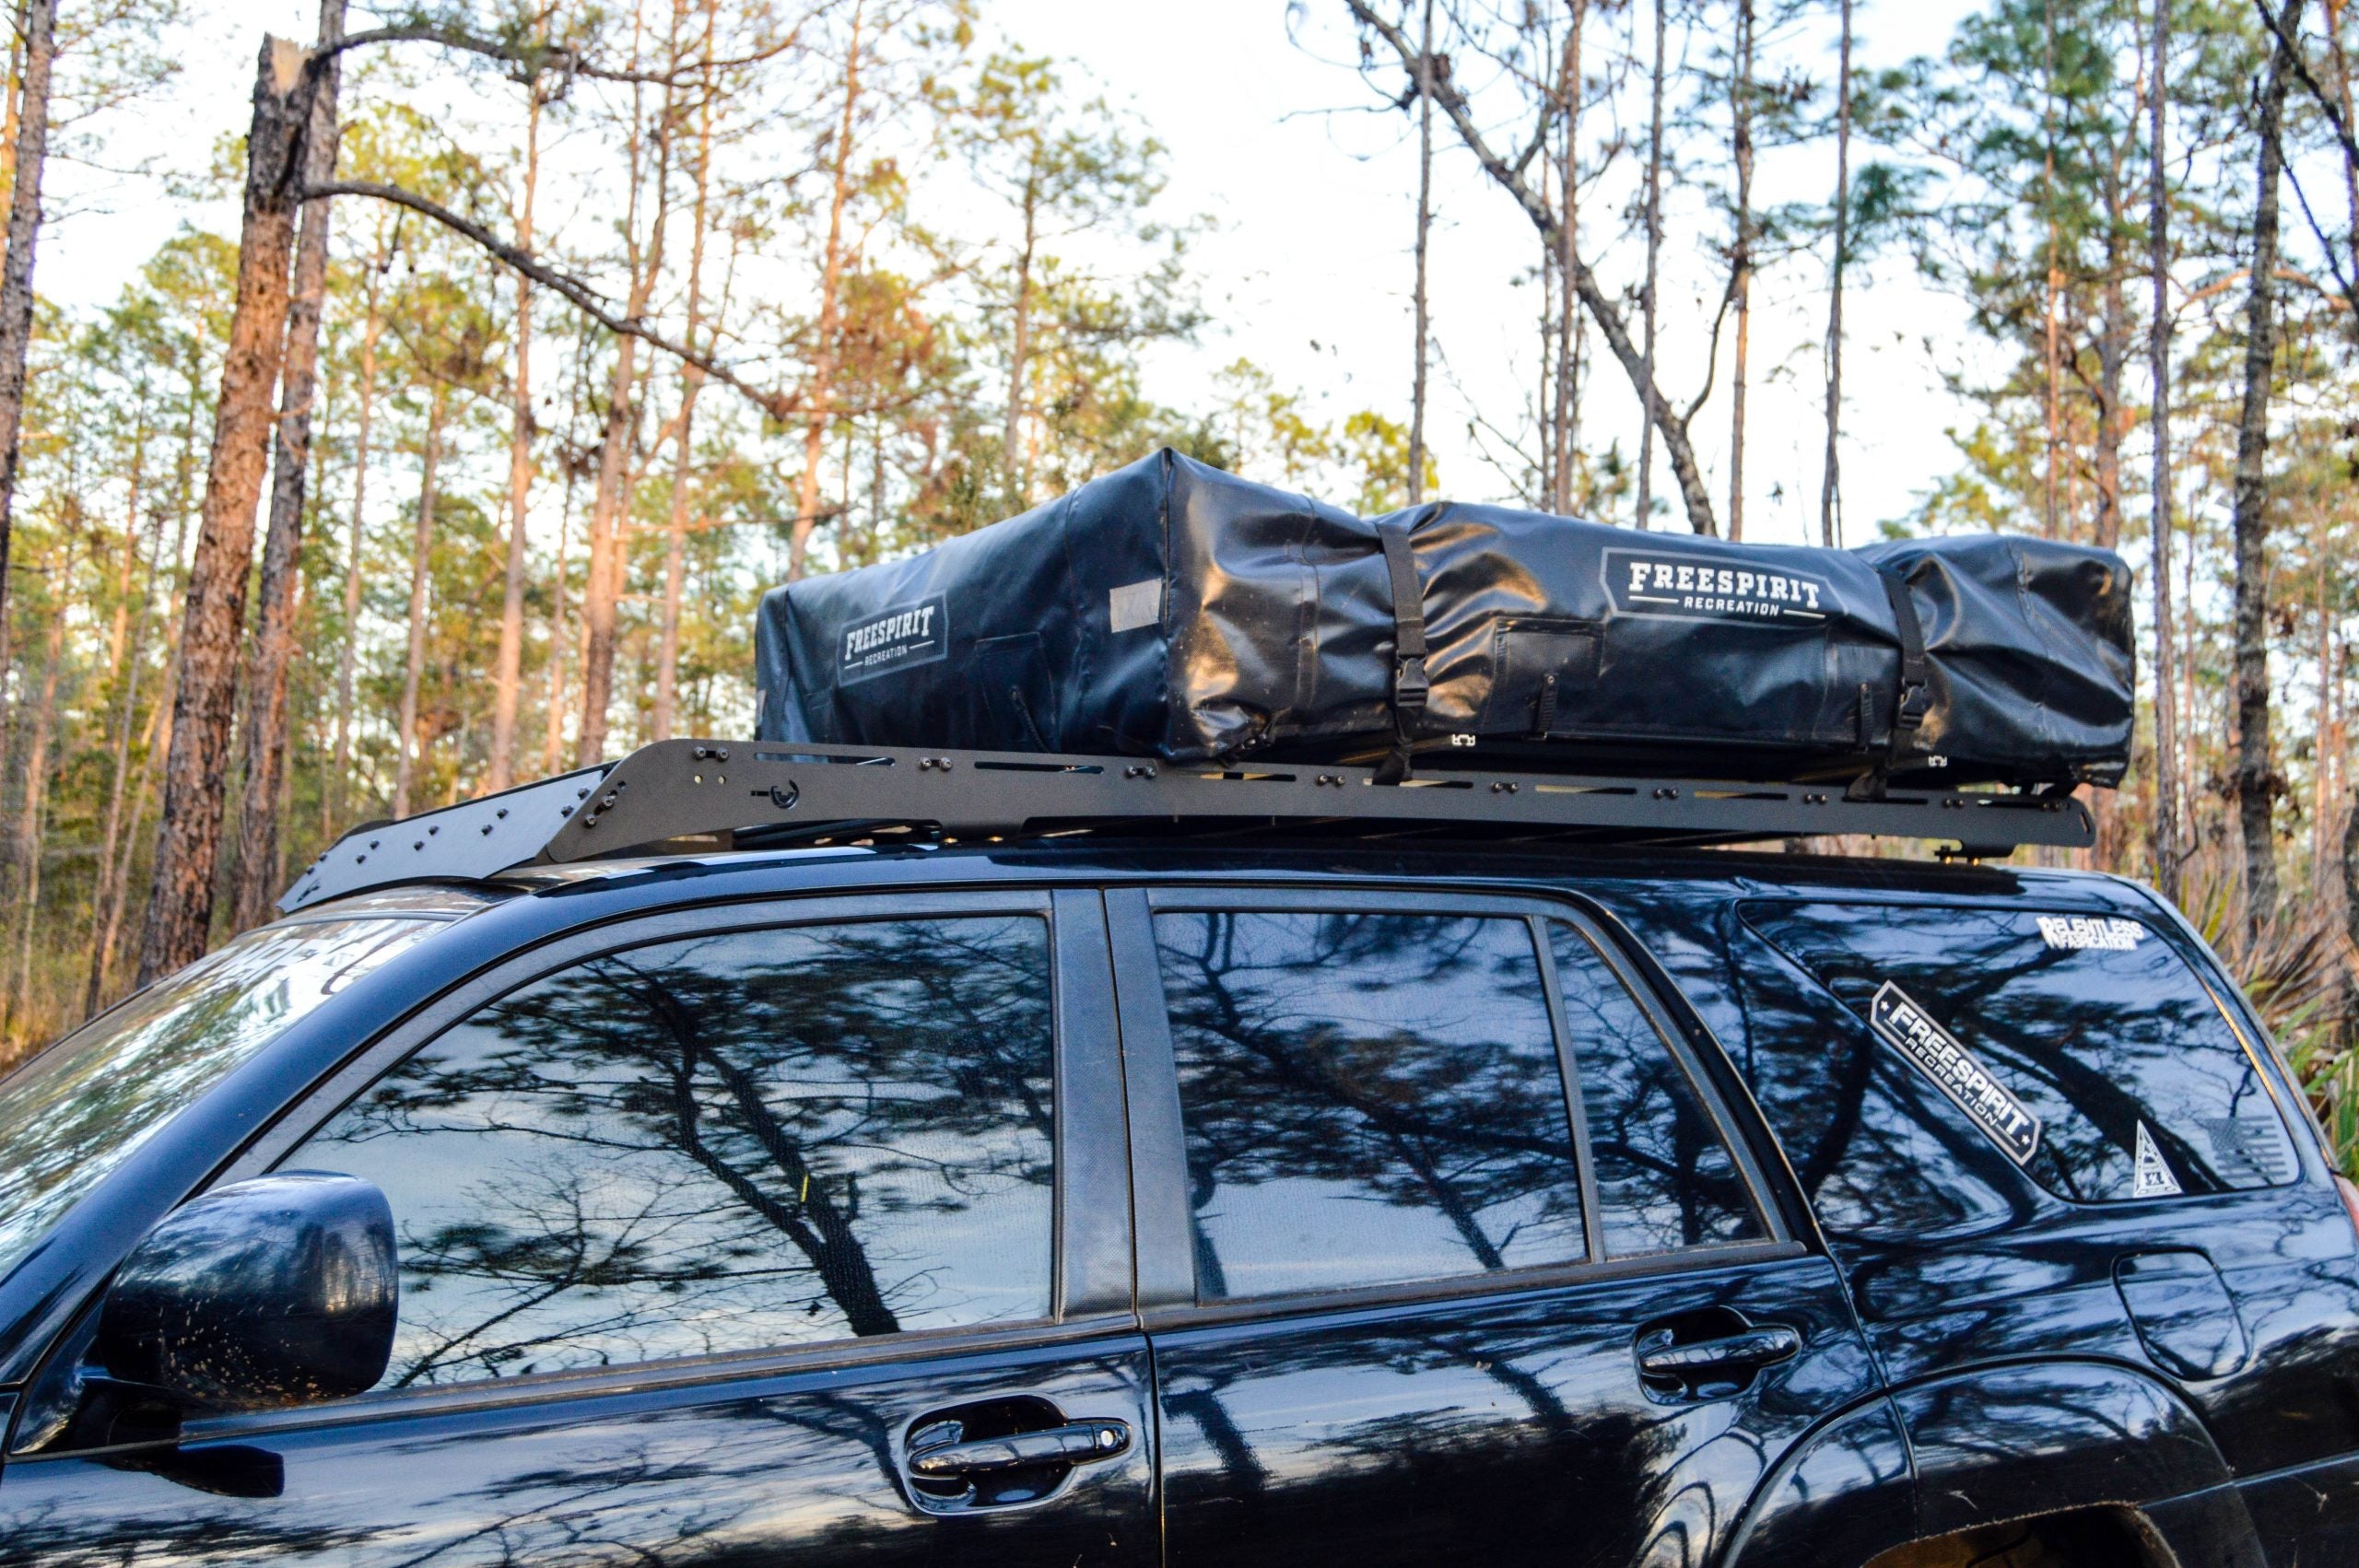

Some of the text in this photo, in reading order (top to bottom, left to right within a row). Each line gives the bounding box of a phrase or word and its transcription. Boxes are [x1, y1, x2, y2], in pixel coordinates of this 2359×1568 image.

[1628, 562, 1820, 609] FREESPIRIT
[1684, 596, 1780, 616] RECREATION
[844, 605, 935, 661] FREESPIRIT
[864, 644, 908, 666] RECREATION
[2036, 916, 2144, 949] RELENTLESS
[1889, 1001, 2029, 1135] FREESPIRIT
[1905, 1037, 1998, 1127] RECREATION
